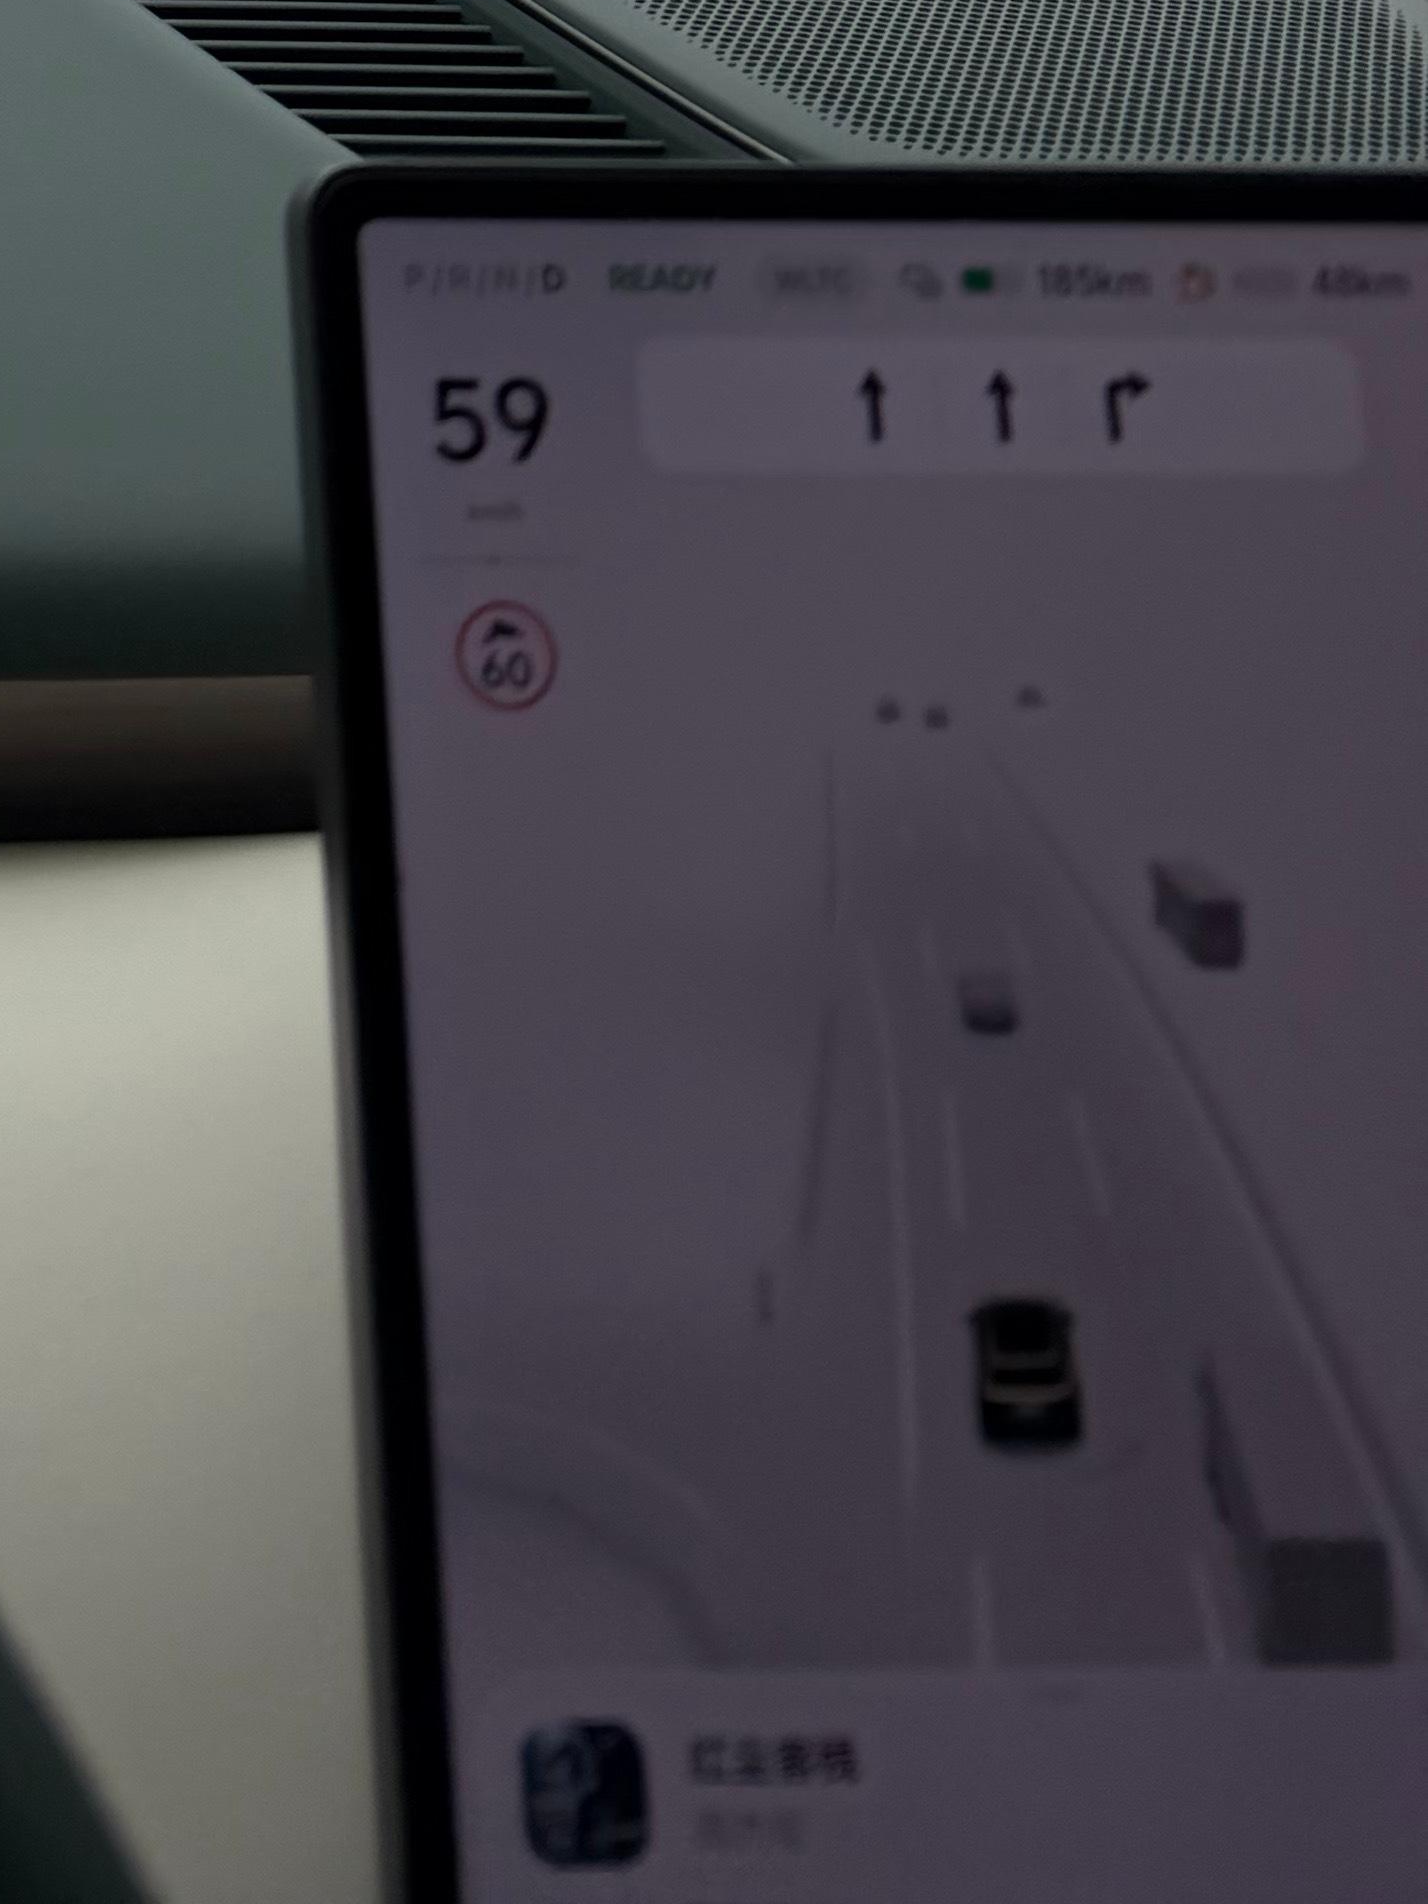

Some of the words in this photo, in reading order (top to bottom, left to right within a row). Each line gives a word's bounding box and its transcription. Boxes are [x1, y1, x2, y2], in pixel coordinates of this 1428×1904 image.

[607, 262, 718, 294] READY
[434, 375, 550, 464] 59
[480, 650, 532, 689] 60
